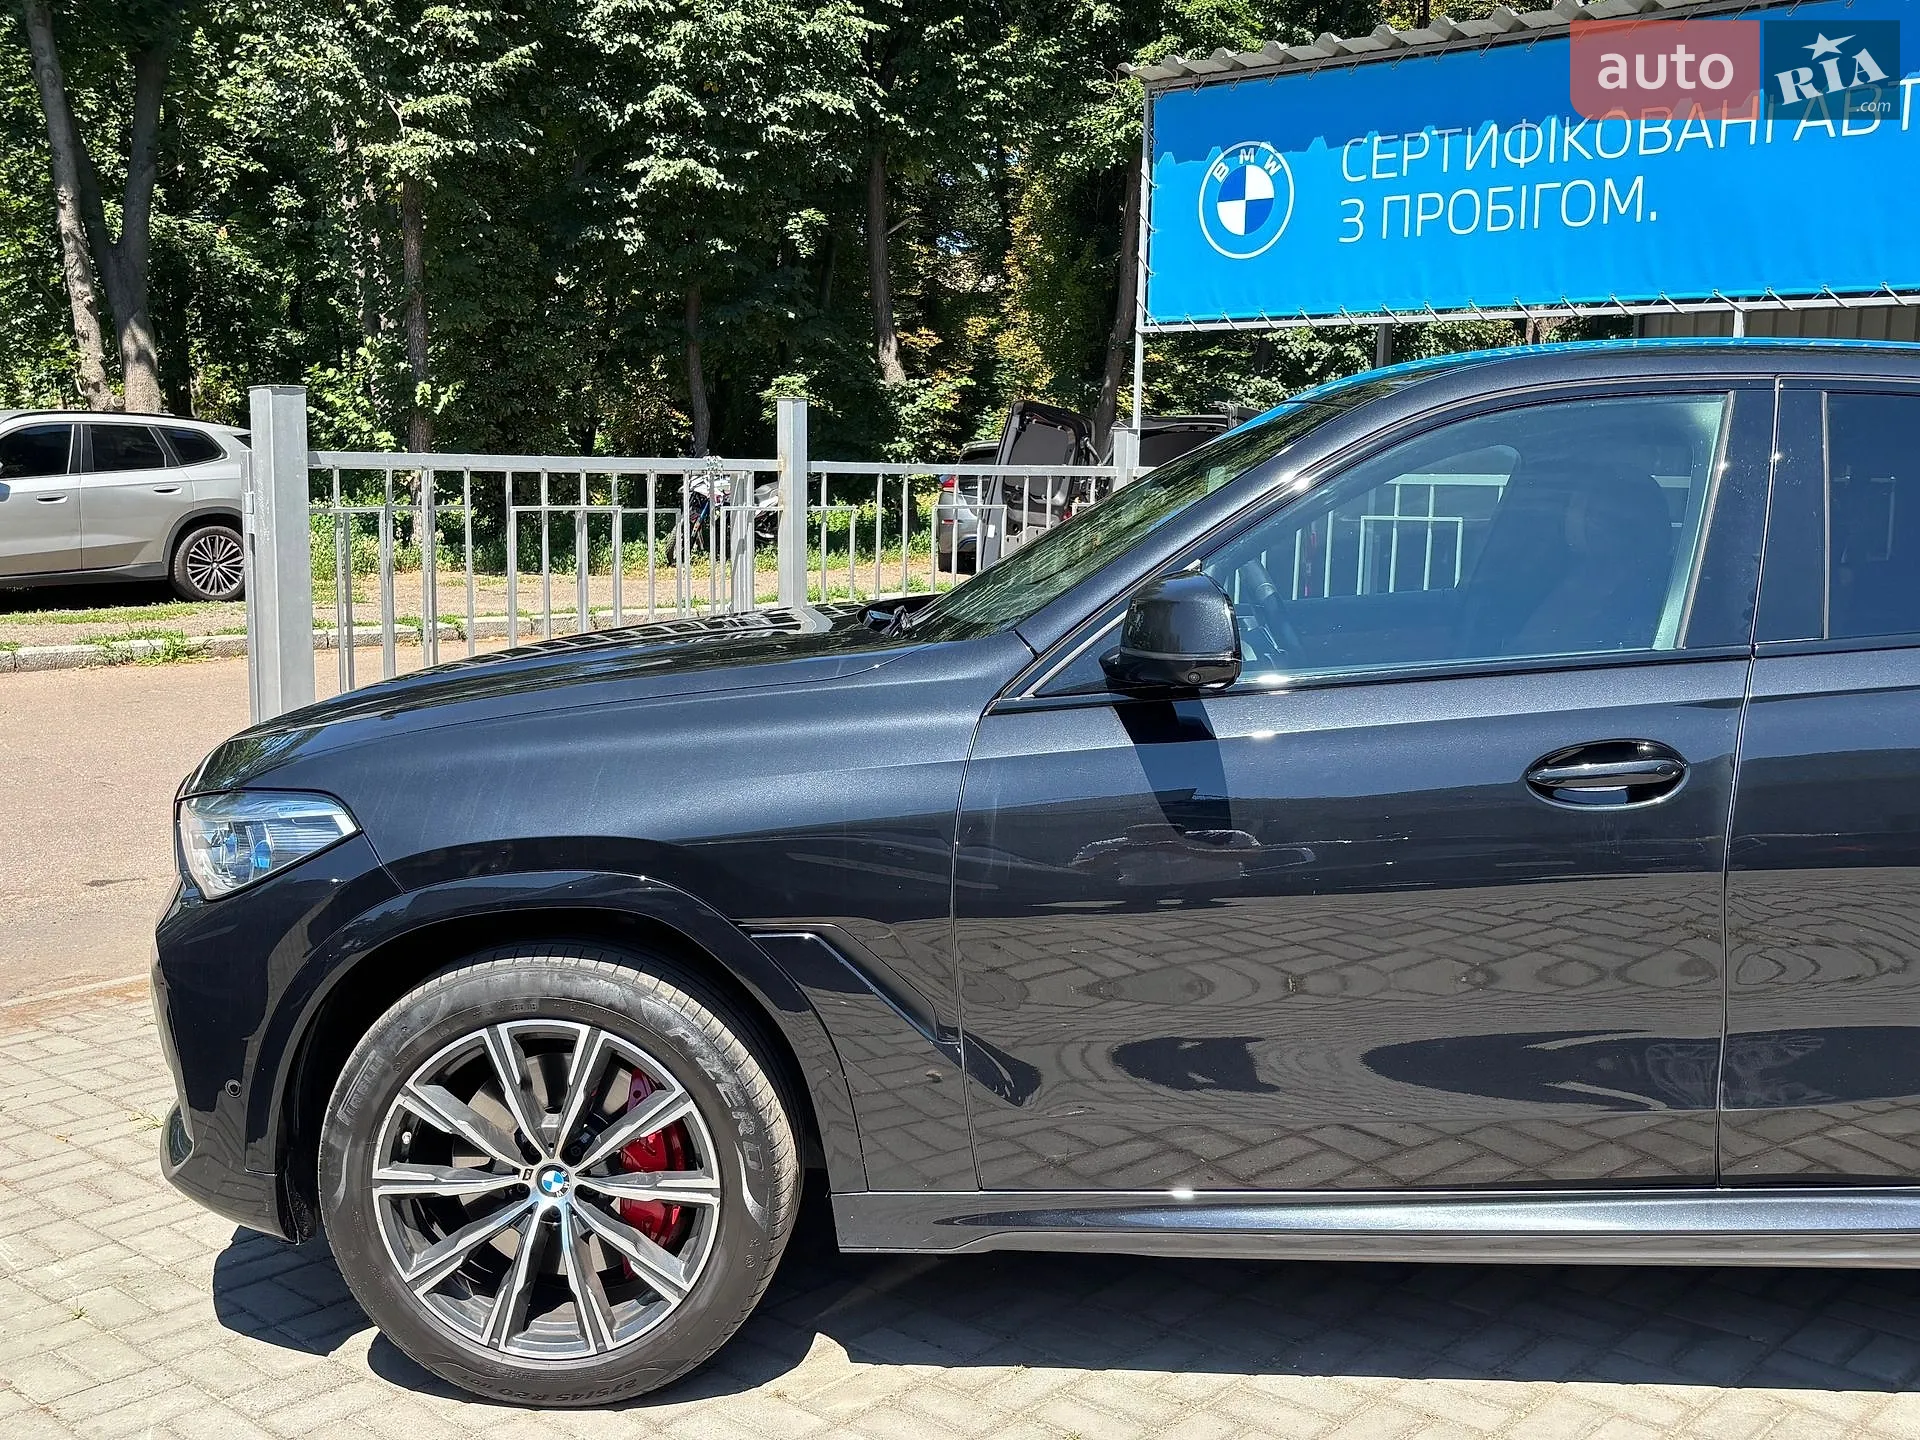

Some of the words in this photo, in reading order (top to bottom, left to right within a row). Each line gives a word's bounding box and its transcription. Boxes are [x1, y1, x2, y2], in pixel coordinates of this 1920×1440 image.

[1212, 147, 1282, 184] BMW
[1341, 93, 1774, 183] СЕРТИФІКОВАНІ
[1338, 197, 1365, 243] З
[1381, 175, 1657, 239] ПРОБІГОМ.
